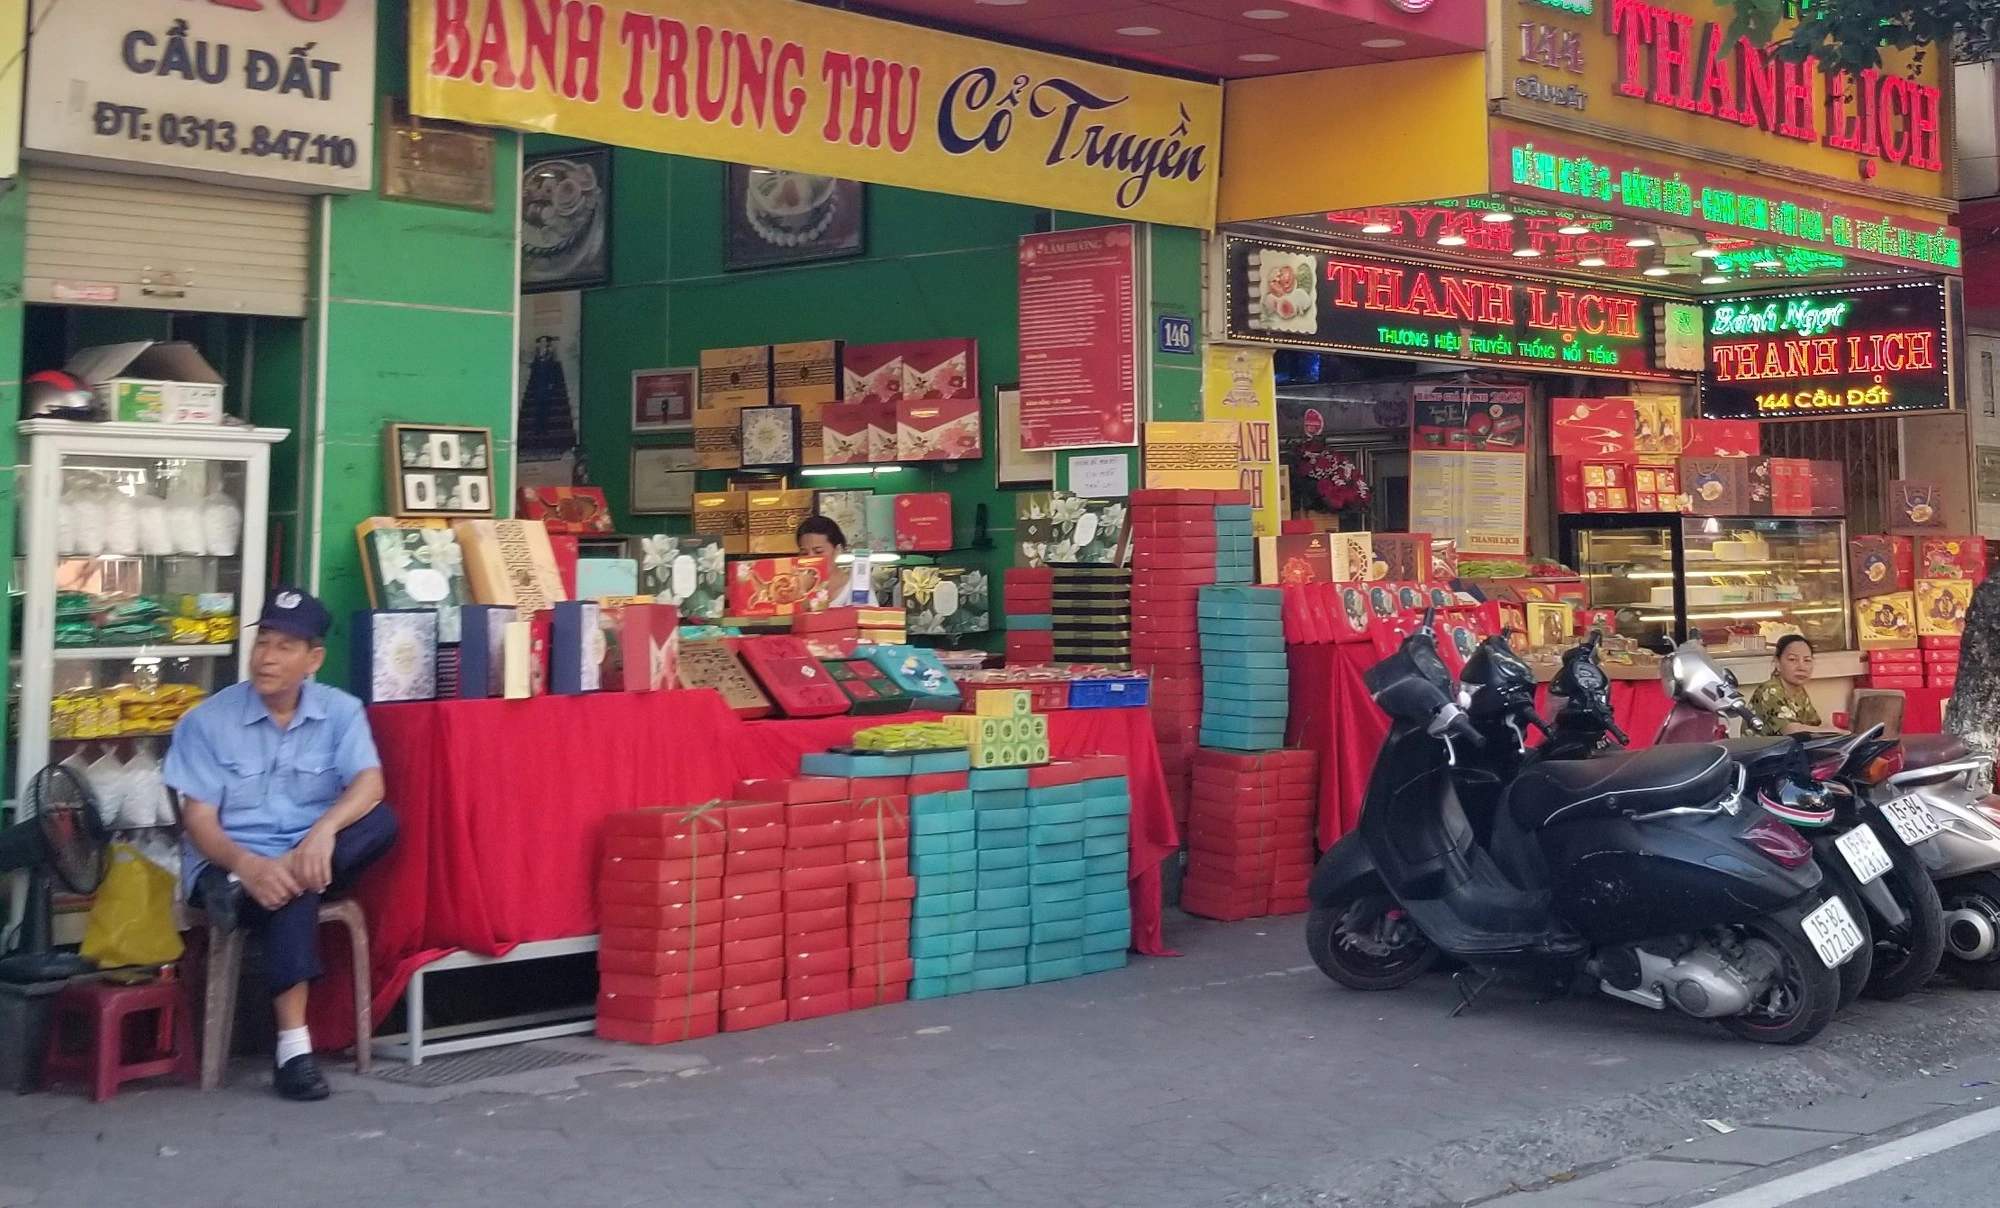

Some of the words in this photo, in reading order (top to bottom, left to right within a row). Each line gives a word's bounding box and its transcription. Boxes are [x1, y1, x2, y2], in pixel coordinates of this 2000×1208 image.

[122, 18, 229, 84] CẦU
[244, 42, 341, 100] ĐẤT
[1518, 20, 1585, 74] 144
[620, 11, 807, 136] TRUNG
[822, 50, 920, 152] THU
[937, 66, 1030, 154] Cổ
[1030, 78, 1206, 208] Truyền
[1608, 0, 1817, 142] THANH
[1826, 62, 1943, 179] LỊCH
[93, 101, 151, 141] ĐT:
[1327, 261, 1514, 325] THANH
[1527, 286, 1640, 343] LỊCH
[1165, 323, 1189, 348] 146
[1434, 331, 1462, 352] HIỆU
[1517, 338, 1556, 359] THỐNG
[1562, 340, 1582, 362] NỔI
[1586, 344, 1618, 365] TIẾNG
[1713, 338, 1839, 382] THANH
[1848, 331, 1933, 384] LỊCH
[1755, 393, 1789, 411] 144
[1794, 389, 1842, 409] Cầu
[1847, 384, 1891, 406] Đất
[1811, 903, 1845, 938] 15-B2
[1819, 923, 1861, 964] 072.01
